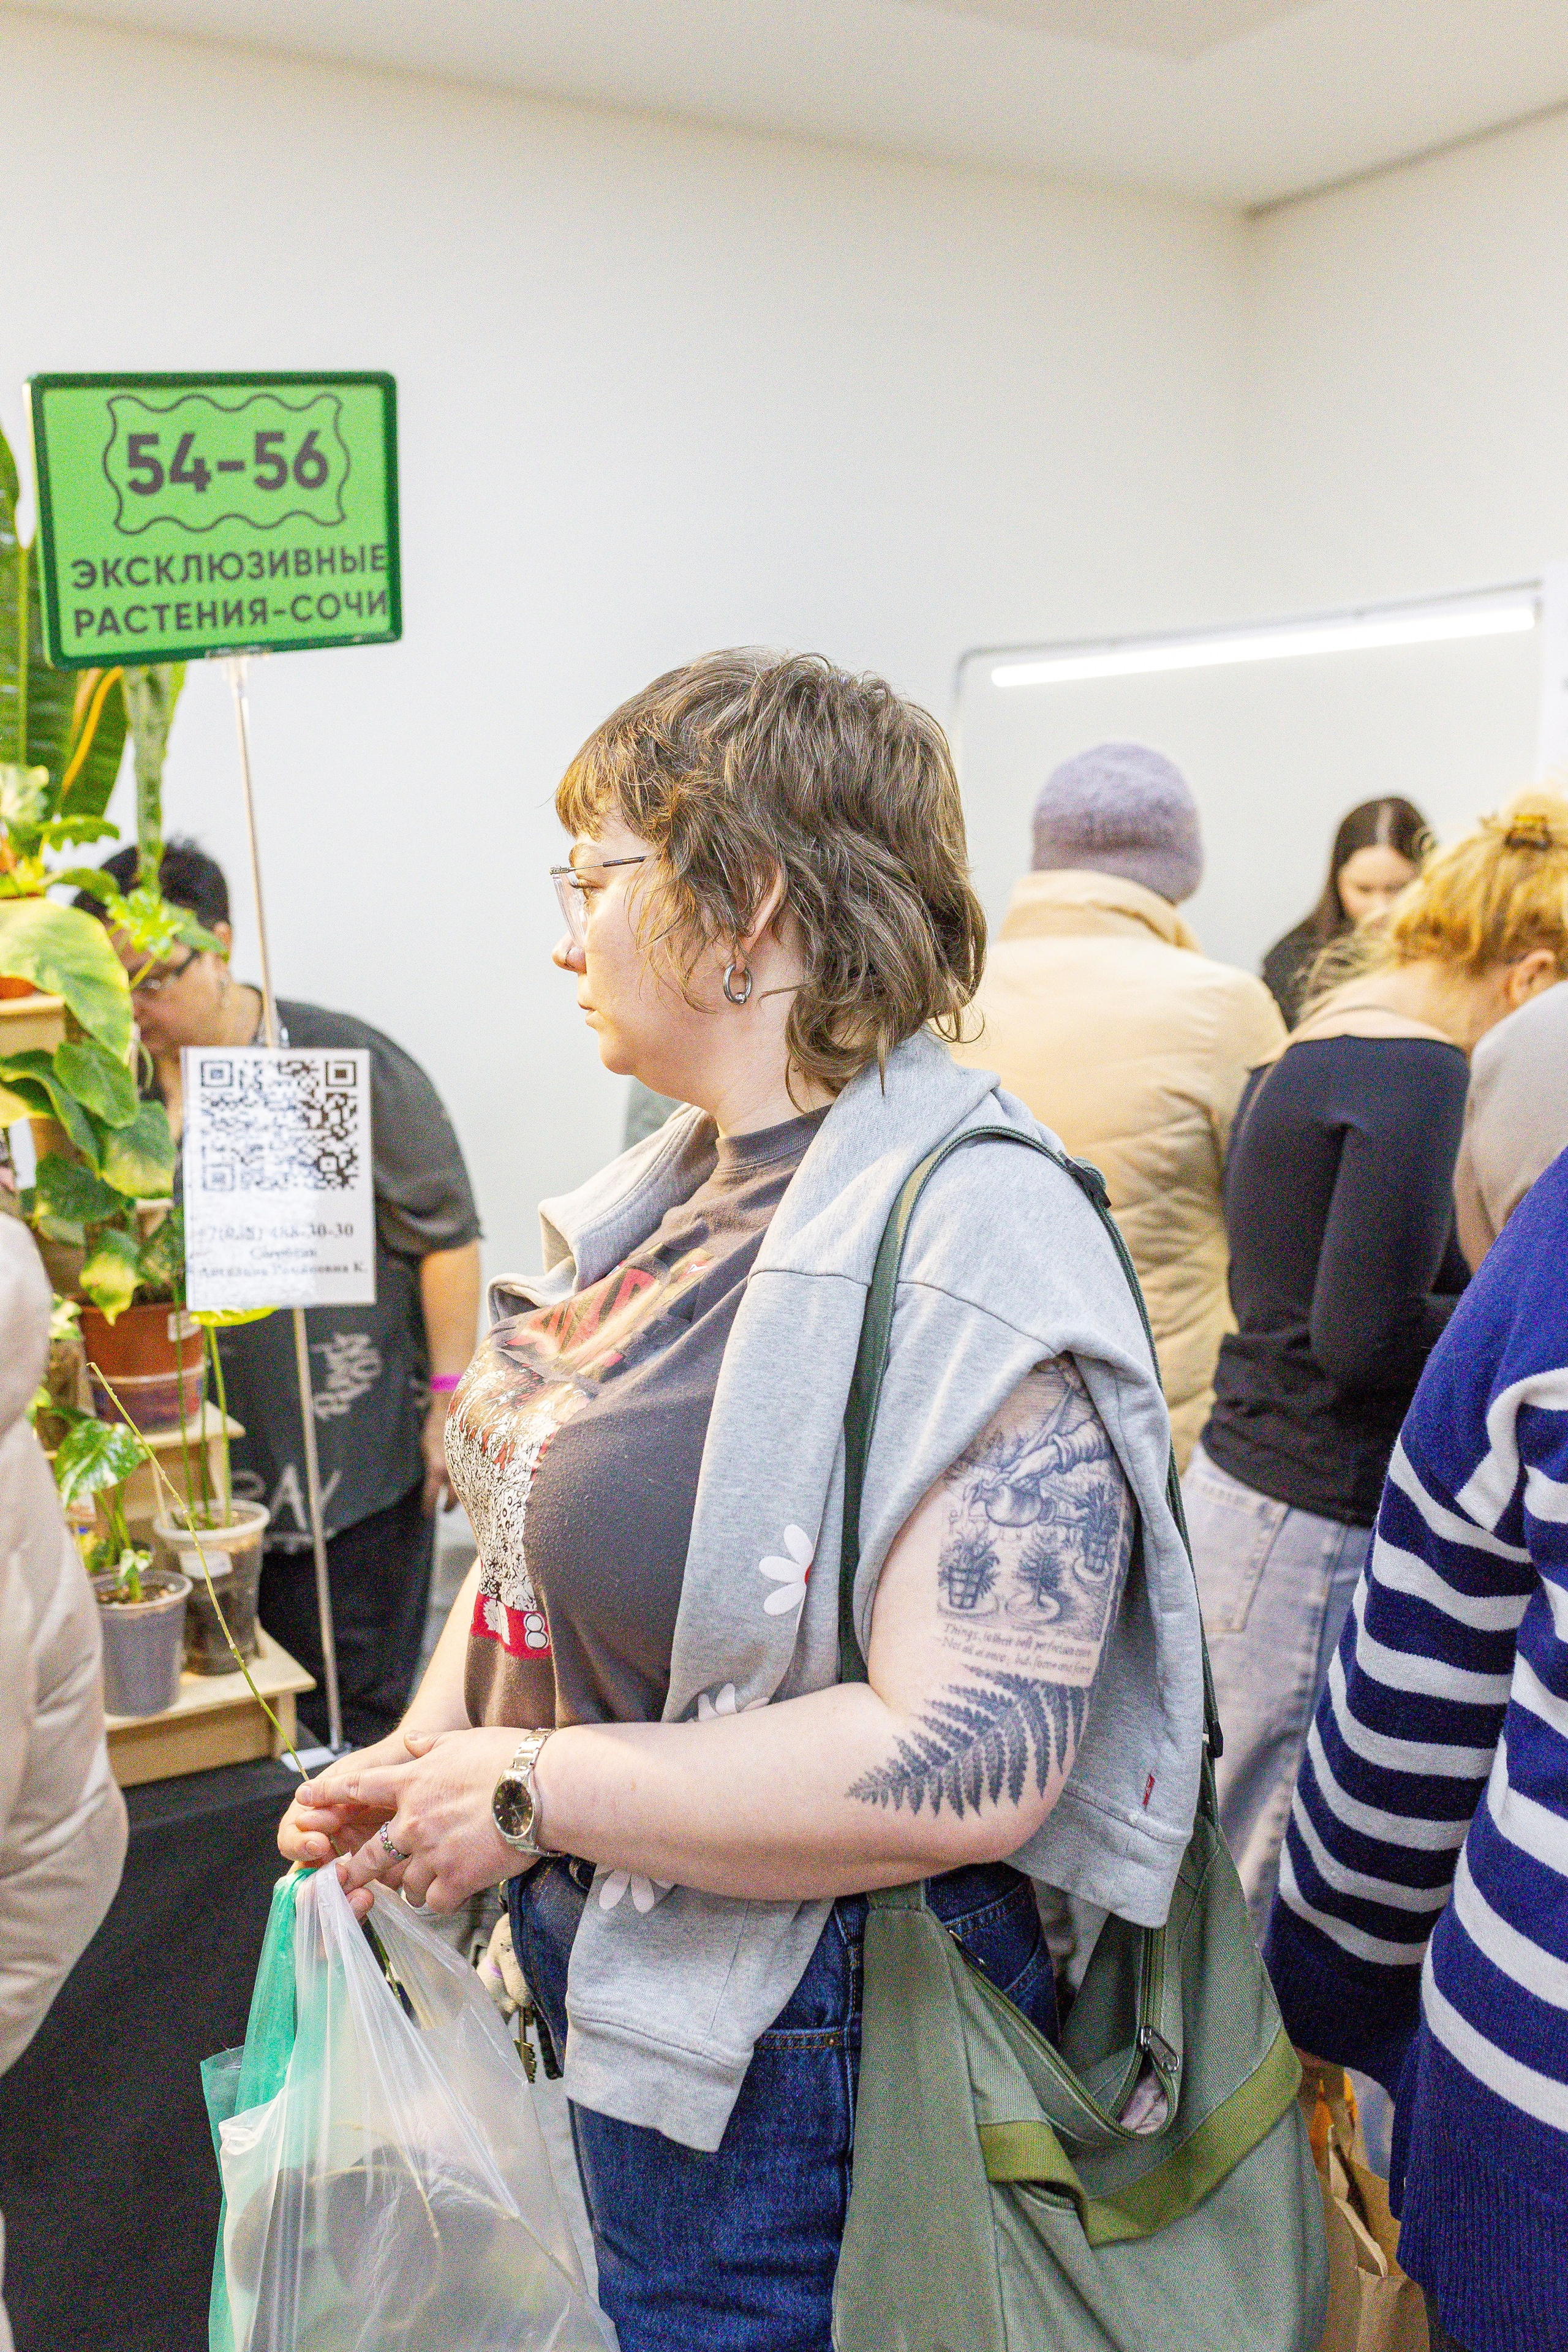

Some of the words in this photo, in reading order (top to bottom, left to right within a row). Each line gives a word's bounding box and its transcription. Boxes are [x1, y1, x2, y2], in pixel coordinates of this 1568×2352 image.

[126, 429, 330, 496] 54-56
[71, 543, 386, 590] ЭКСКЛЮЗИВНЫЕ
[74, 588, 386, 639] РАСТЕНИЯ-СОЧИ
[271, 1221, 354, 1240] -30-30
